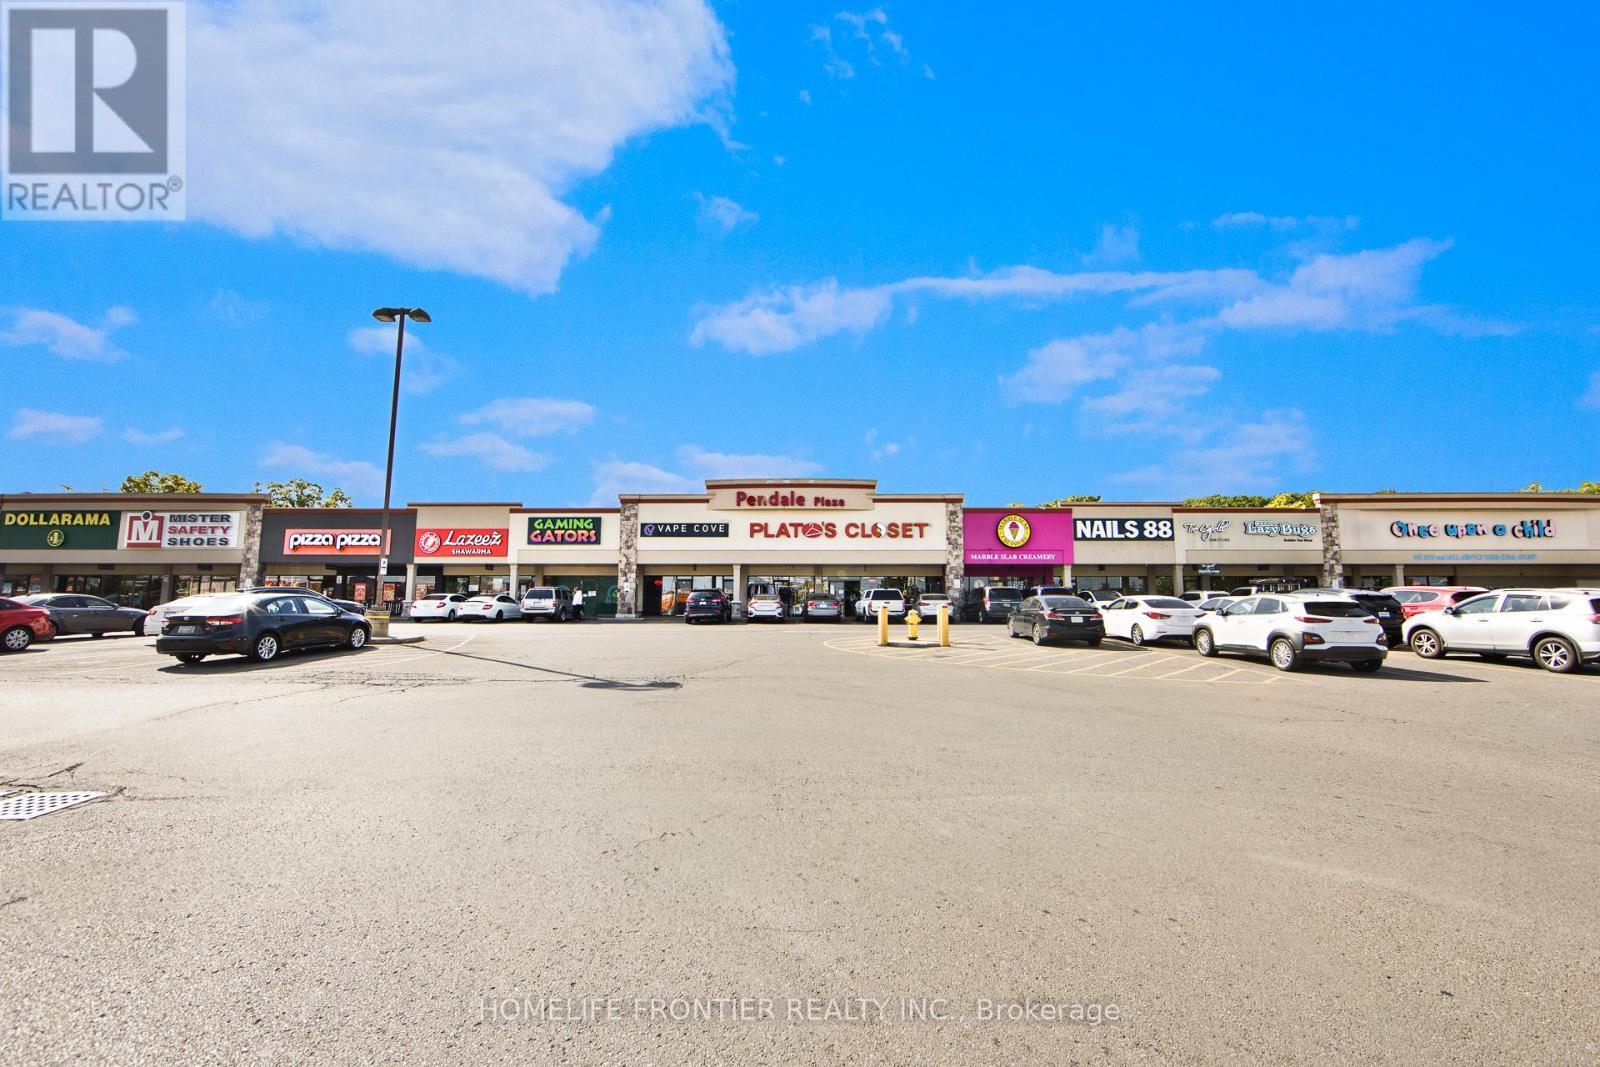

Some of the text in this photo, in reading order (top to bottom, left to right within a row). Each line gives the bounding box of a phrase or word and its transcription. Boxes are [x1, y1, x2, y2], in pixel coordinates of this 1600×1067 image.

[736, 491, 845, 507] Pendale Plaza
[4, 513, 111, 526] DOLLARAMA
[169, 514, 231, 523] MISTER
[534, 518, 594, 529] GAMING
[168, 525, 231, 535] SAFETY
[657, 524, 725, 533] VAPE COVE
[749, 521, 929, 539] PLATO'S CLOSET
[1076, 520, 1173, 538] NAILS 88
[1246, 522, 1280, 537] Lazy
[1280, 523, 1317, 537] Bugs
[1390, 520, 1440, 538] Once
[1445, 523, 1488, 538] upon
[1511, 520, 1556, 539] child
[167, 537, 229, 546] SHOES
[289, 533, 382, 551] pizza pizza
[529, 530, 597, 543] GATORS
